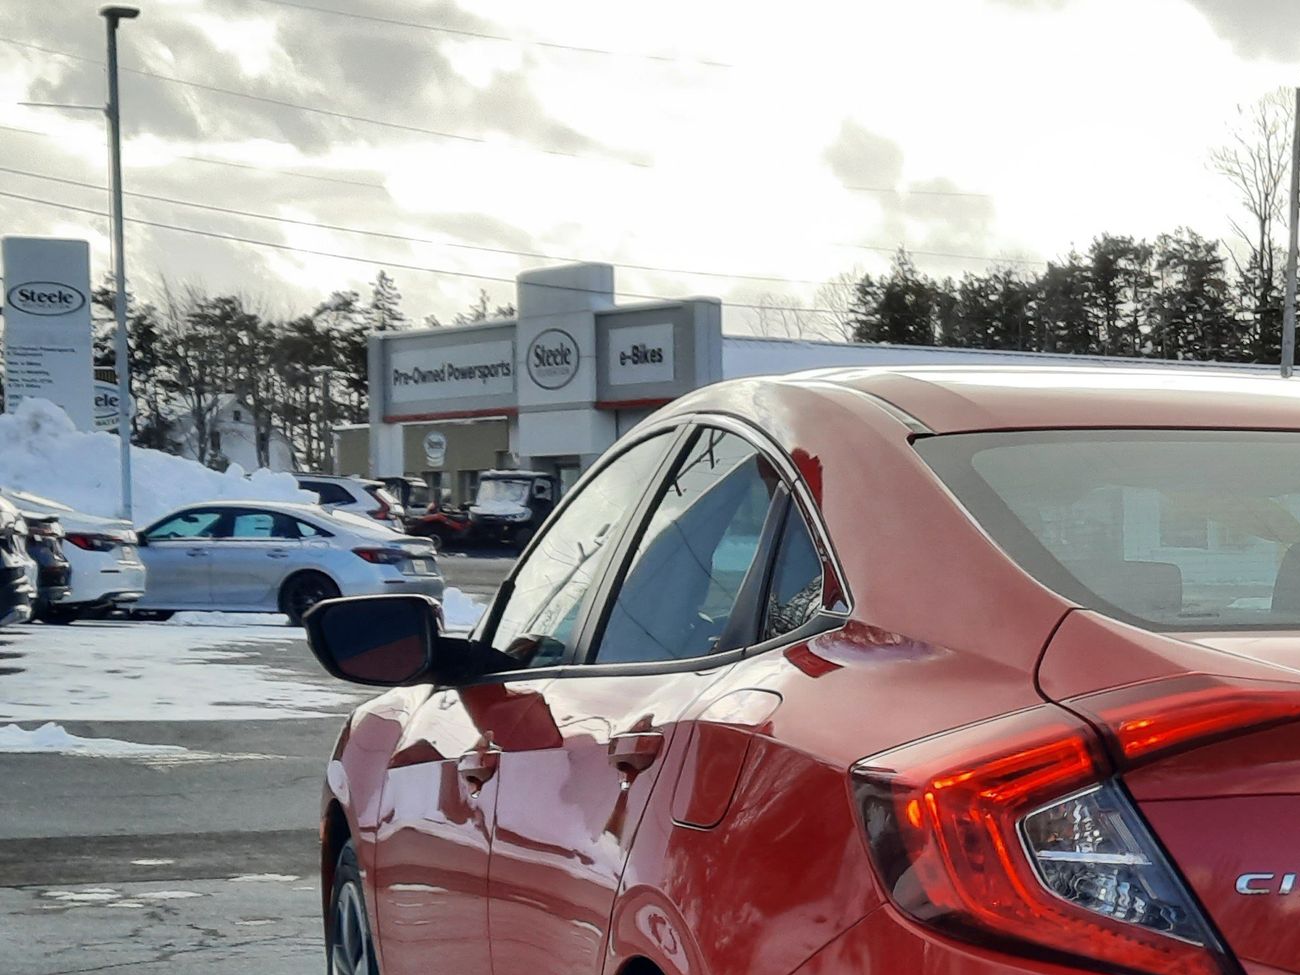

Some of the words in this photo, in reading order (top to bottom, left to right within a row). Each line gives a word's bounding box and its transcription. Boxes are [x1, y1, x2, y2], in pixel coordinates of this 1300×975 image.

[18, 288, 74, 304] Steele
[534, 343, 572, 368] Steele
[619, 343, 664, 366] e-Bikes
[393, 361, 446, 386] Pre-Owned
[446, 360, 511, 385] Powersports
